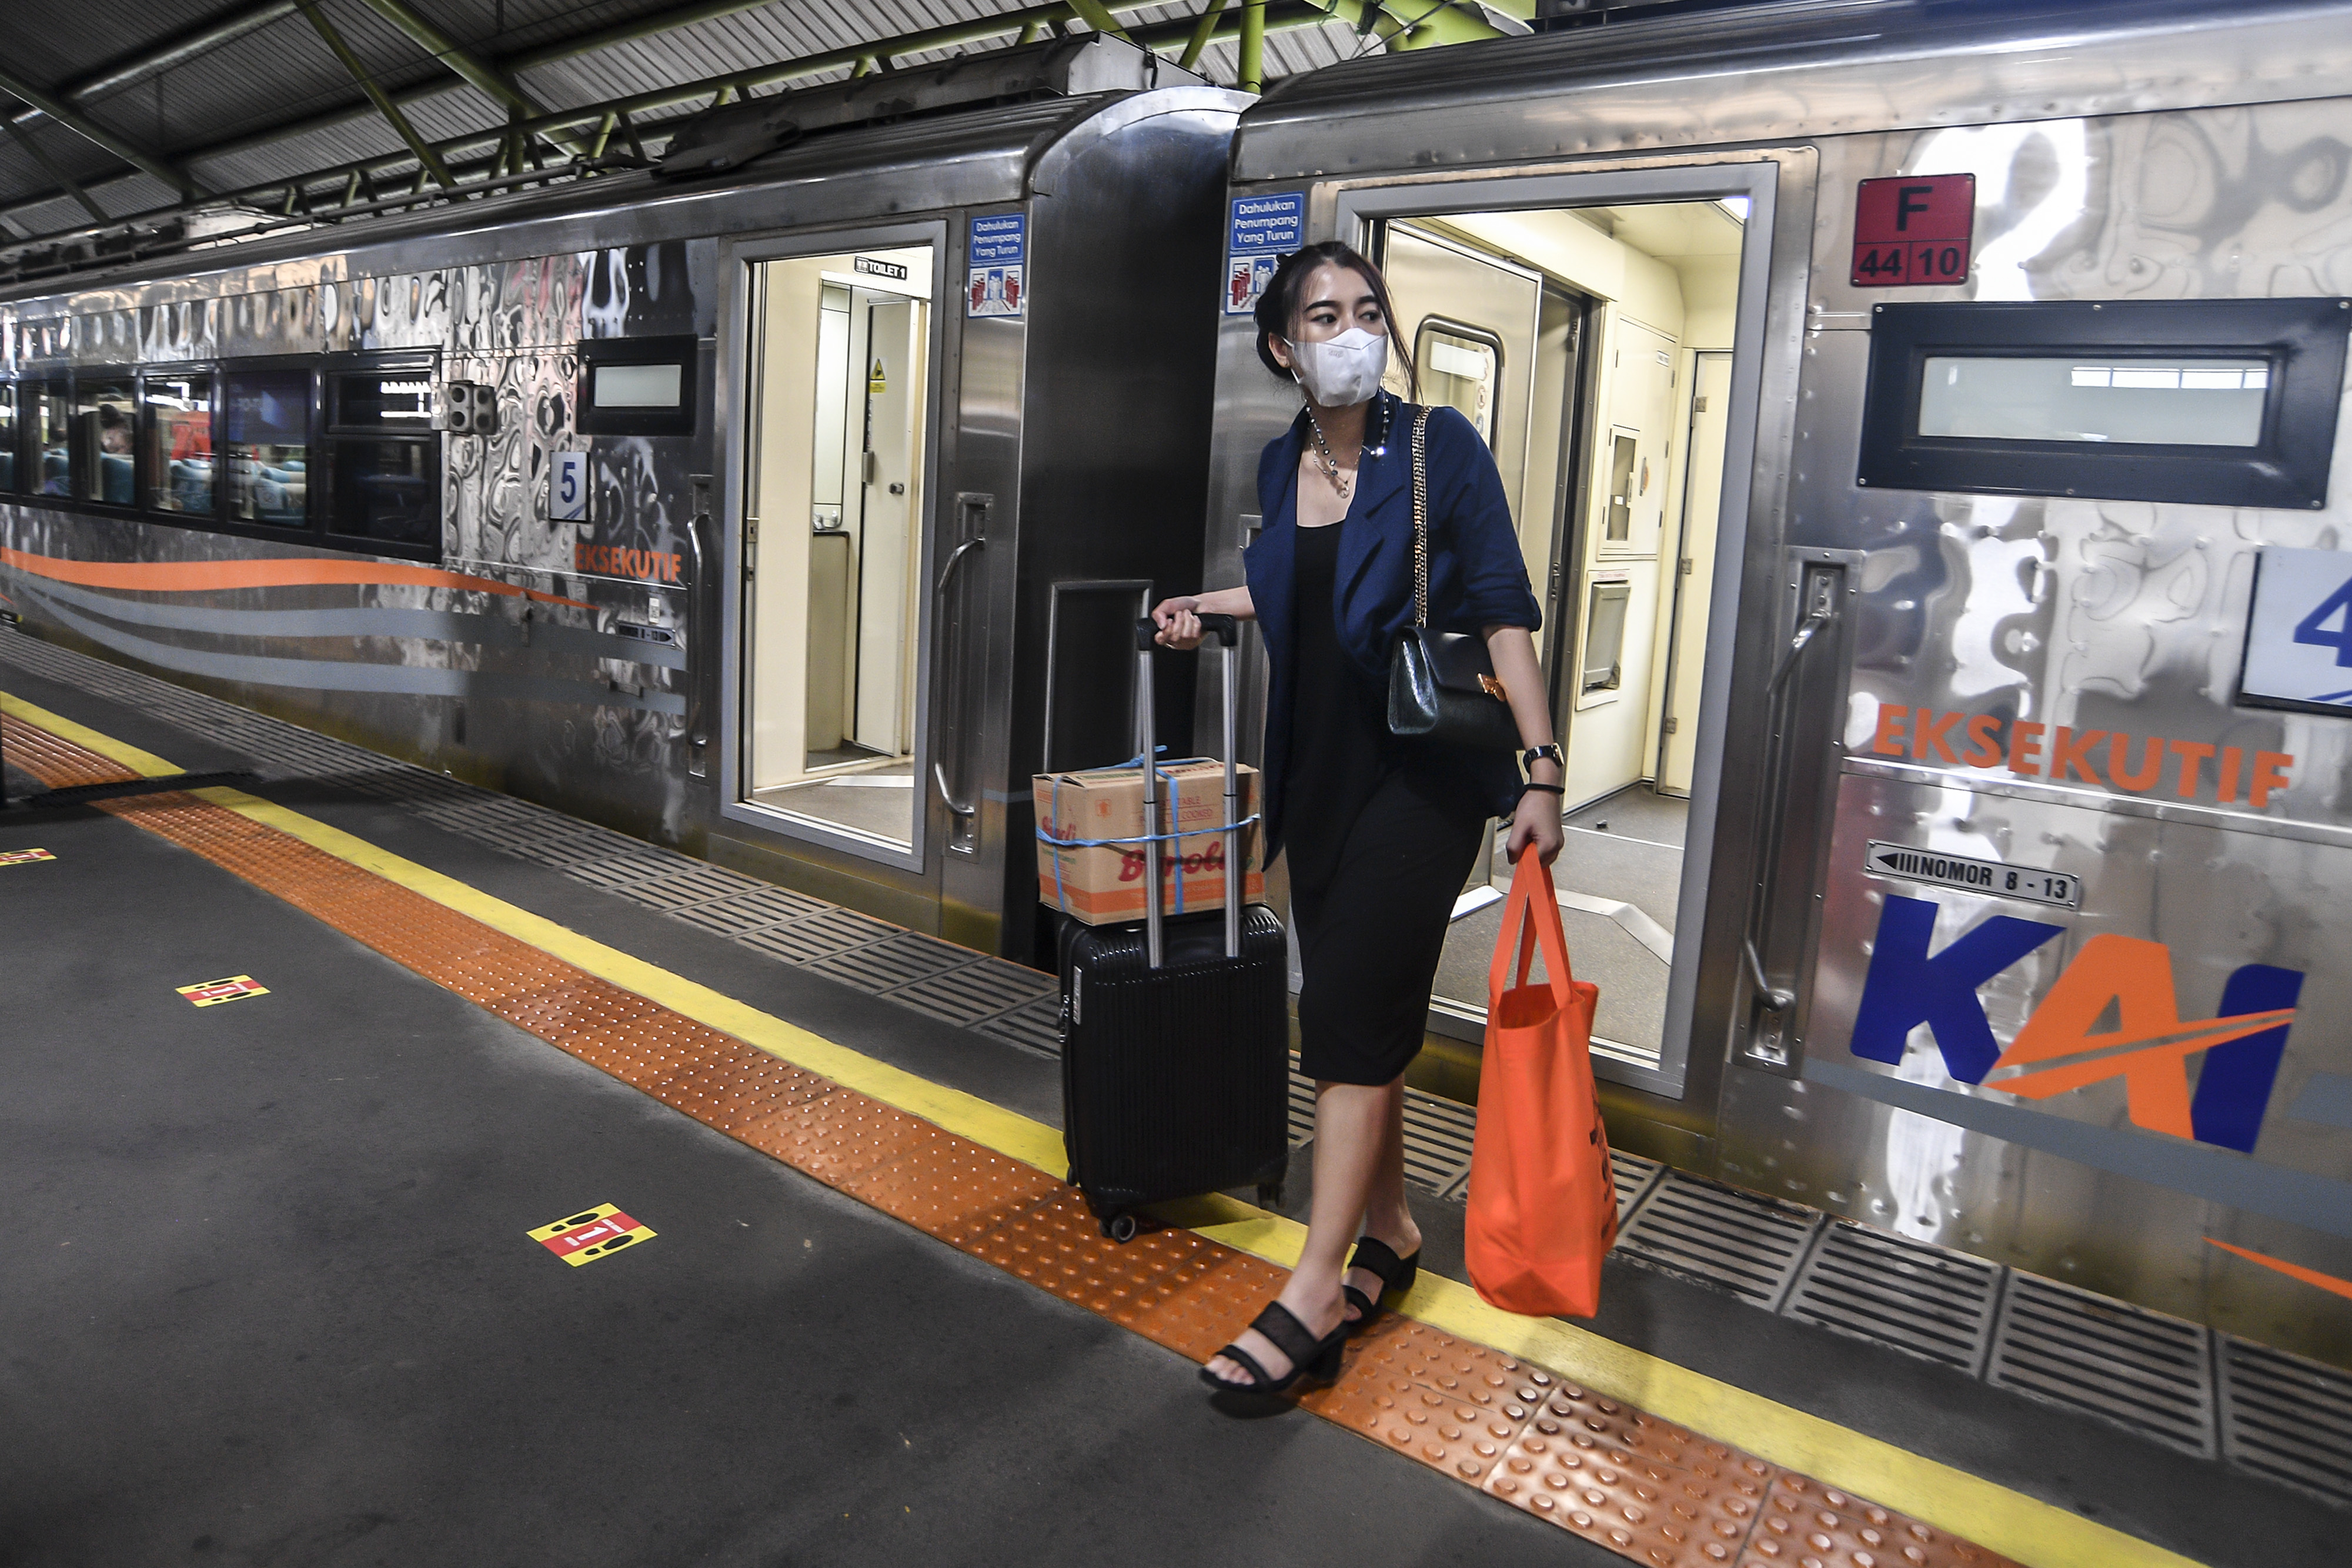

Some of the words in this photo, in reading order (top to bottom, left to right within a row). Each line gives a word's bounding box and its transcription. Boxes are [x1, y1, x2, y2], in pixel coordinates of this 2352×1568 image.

[1235, 216, 1298, 229] Penumpang
[1239, 200, 1295, 215] Dahulukan
[1897, 185, 1933, 231] F
[973, 233, 1021, 245] Penumpang
[976, 220, 1019, 232] Dahulukan
[1237, 232, 1264, 244] Yang
[1266, 230, 1294, 241] Turun
[975, 248, 996, 258] Yang
[997, 245, 1018, 255] Turun
[1859, 248, 1903, 277] 44
[1919, 246, 1960, 276] 10
[868, 261, 900, 277] TOILET
[900, 268, 906, 279] 1
[560, 462, 577, 503] 5
[575, 543, 681, 582] EKSEKUTIF
[2293, 576, 2352, 668] 4
[1872, 703, 2294, 808] EKSEKUTIF
[1920, 857, 1992, 887] NOMOR
[2004, 871, 2018, 891] 8
[2043, 877, 2067, 900] 13
[1850, 893, 2305, 1154] KAI
